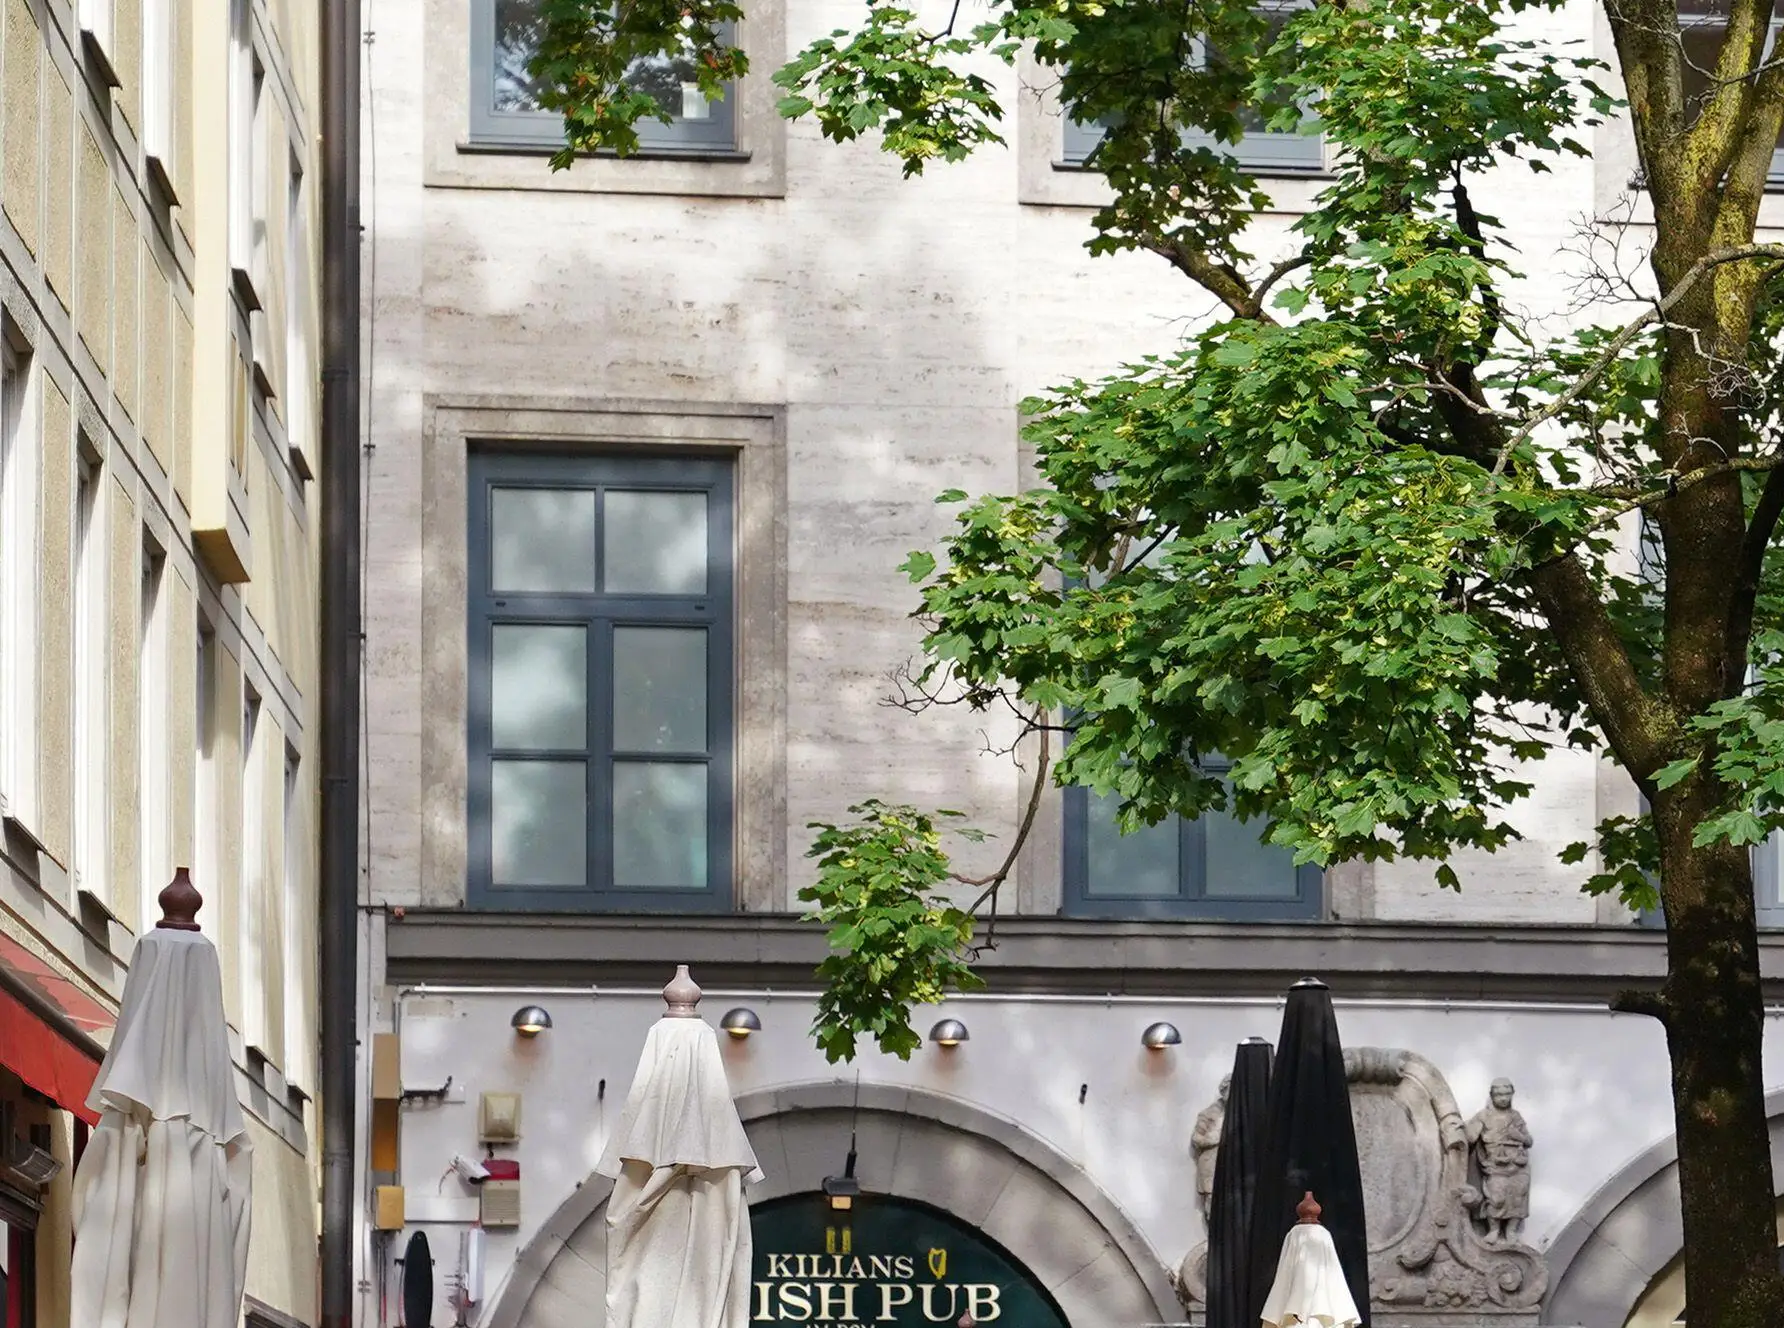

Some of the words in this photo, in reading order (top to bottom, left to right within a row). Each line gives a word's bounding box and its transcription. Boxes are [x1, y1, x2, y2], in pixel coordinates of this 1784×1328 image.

[766, 1253, 915, 1280] KILIANS
[752, 1282, 860, 1322] ISH
[875, 1283, 1002, 1323] PUB
